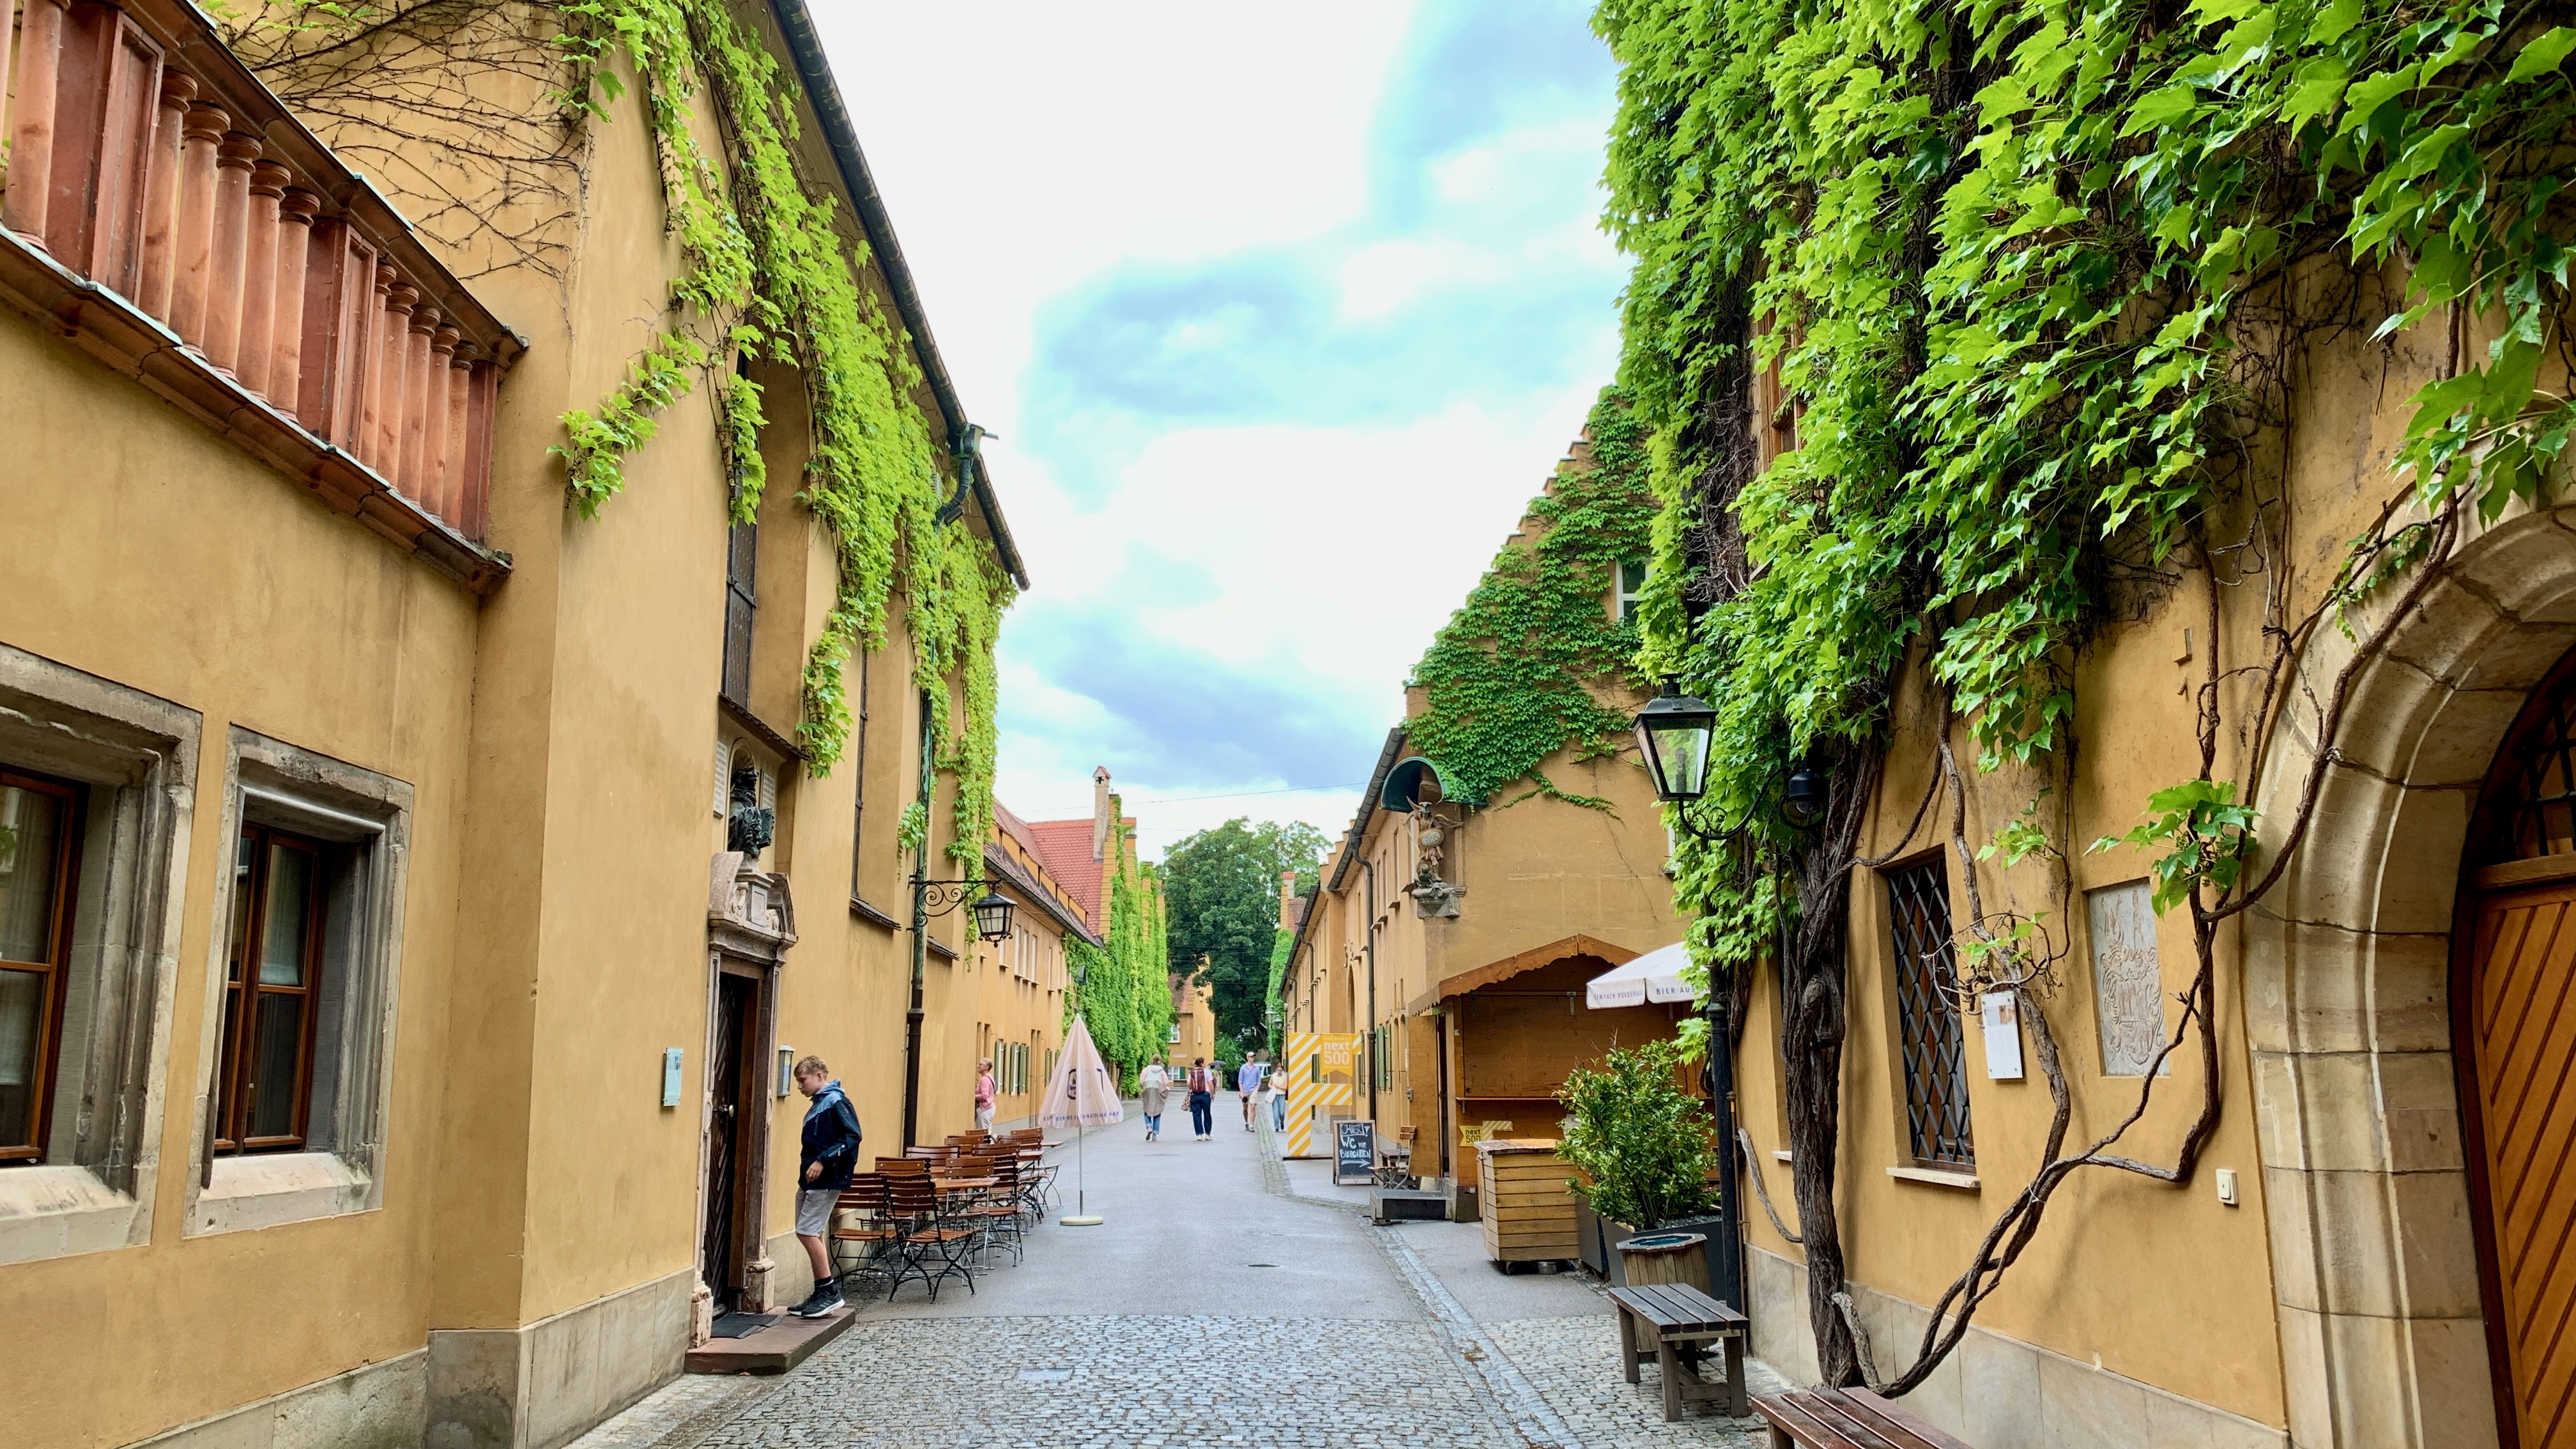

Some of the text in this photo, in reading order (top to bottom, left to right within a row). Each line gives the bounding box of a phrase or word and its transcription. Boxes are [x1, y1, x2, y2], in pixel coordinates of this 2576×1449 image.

[1324, 1042, 1350, 1051] next
[1324, 1051, 1350, 1065] 500
[1340, 1136, 1357, 1149] WC
